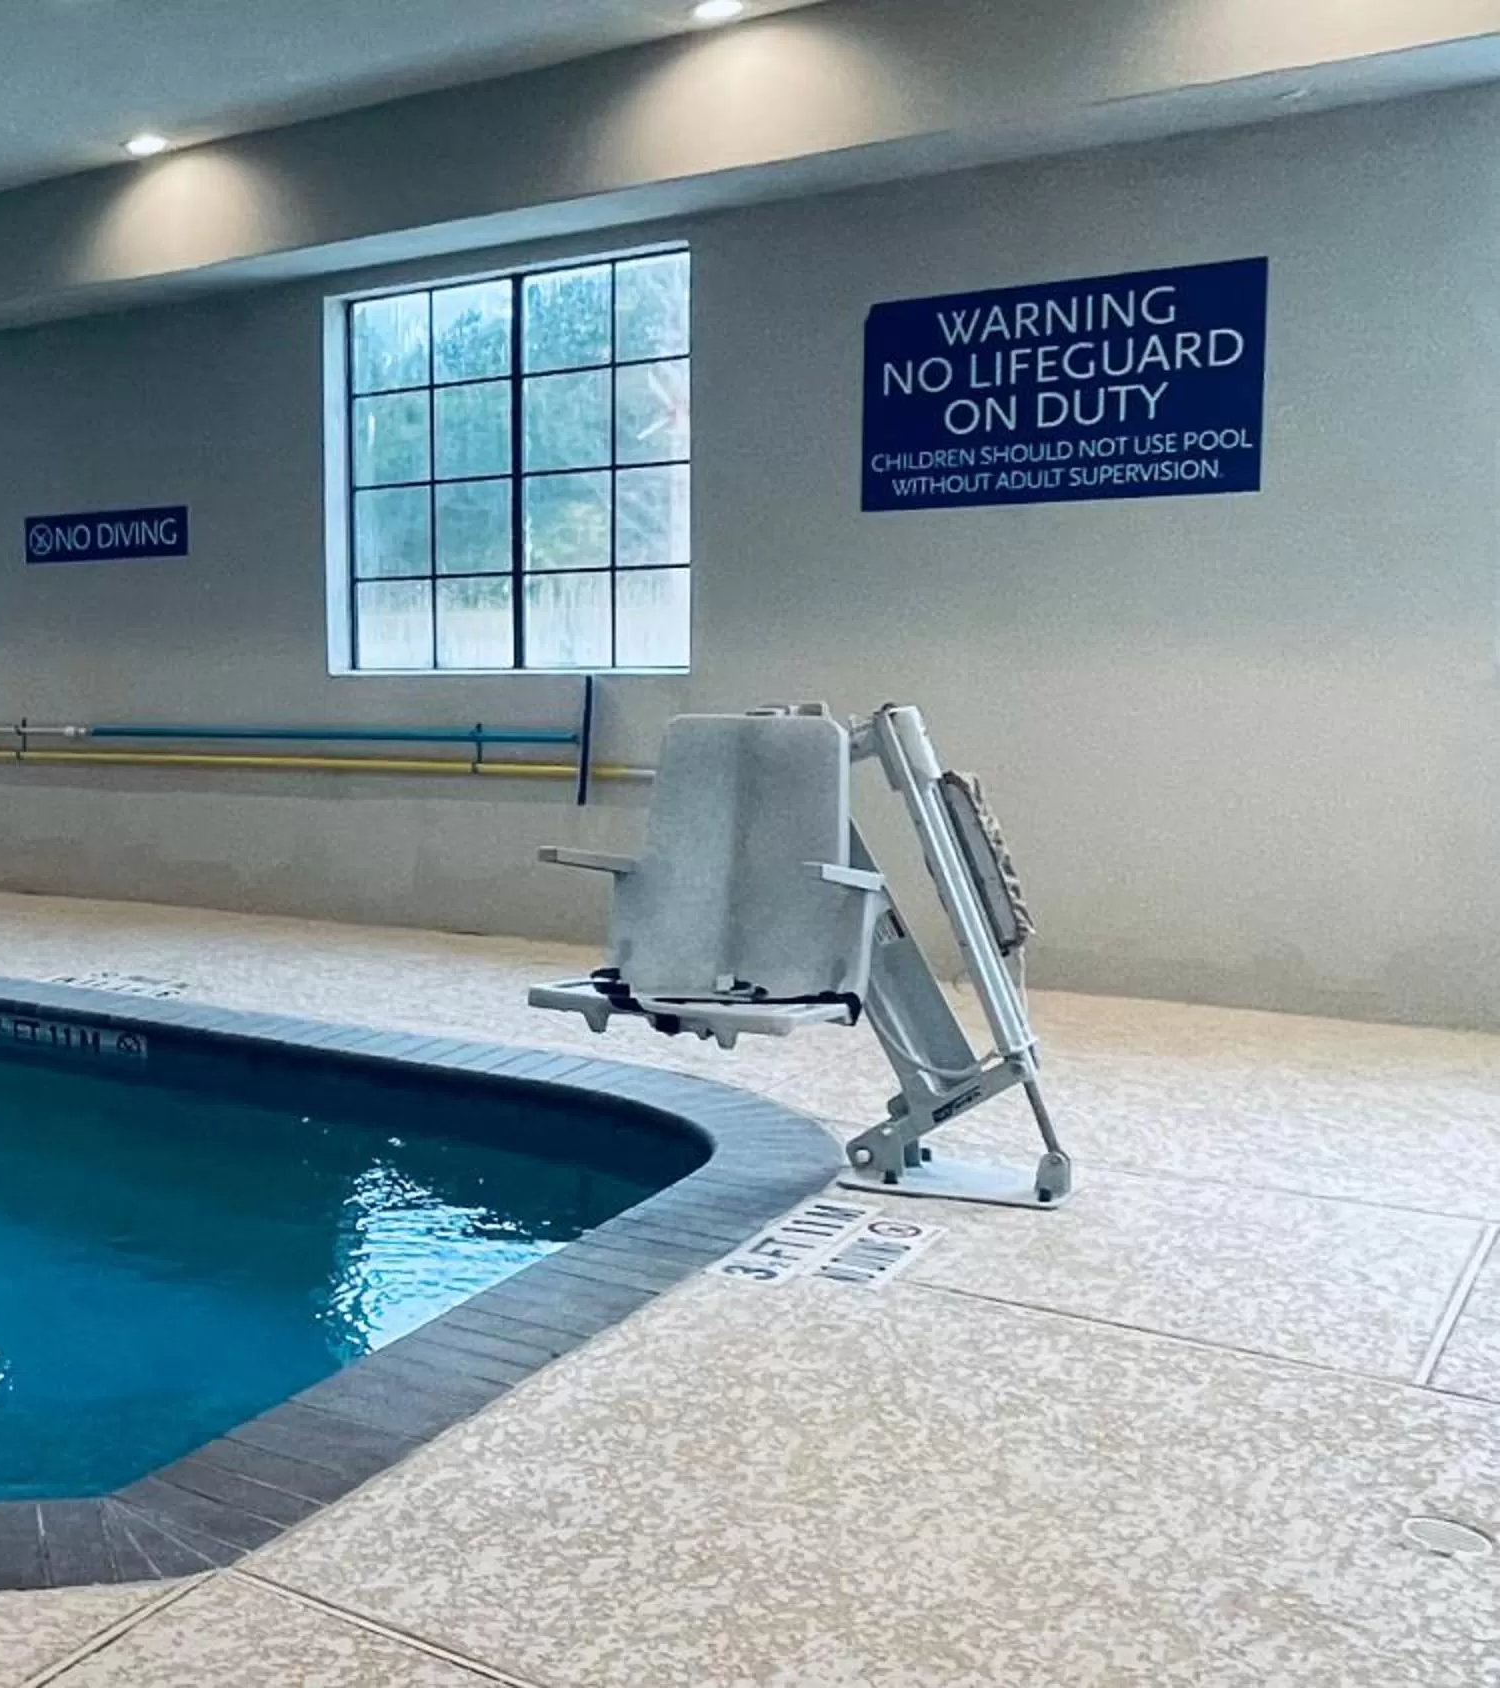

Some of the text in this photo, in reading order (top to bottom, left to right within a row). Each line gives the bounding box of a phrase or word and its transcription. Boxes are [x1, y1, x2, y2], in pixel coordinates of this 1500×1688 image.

[936, 286, 1176, 346] WARNING
[883, 328, 1244, 396] NO LIFEGUARD
[944, 382, 1169, 435] ON DUTY
[871, 428, 1253, 473] CHILDREN SHOULD NOT USE POOL
[891, 472, 993, 496] WITHOUT
[995, 467, 1065, 490] ADULT
[55, 518, 177, 551] NO DIVING
